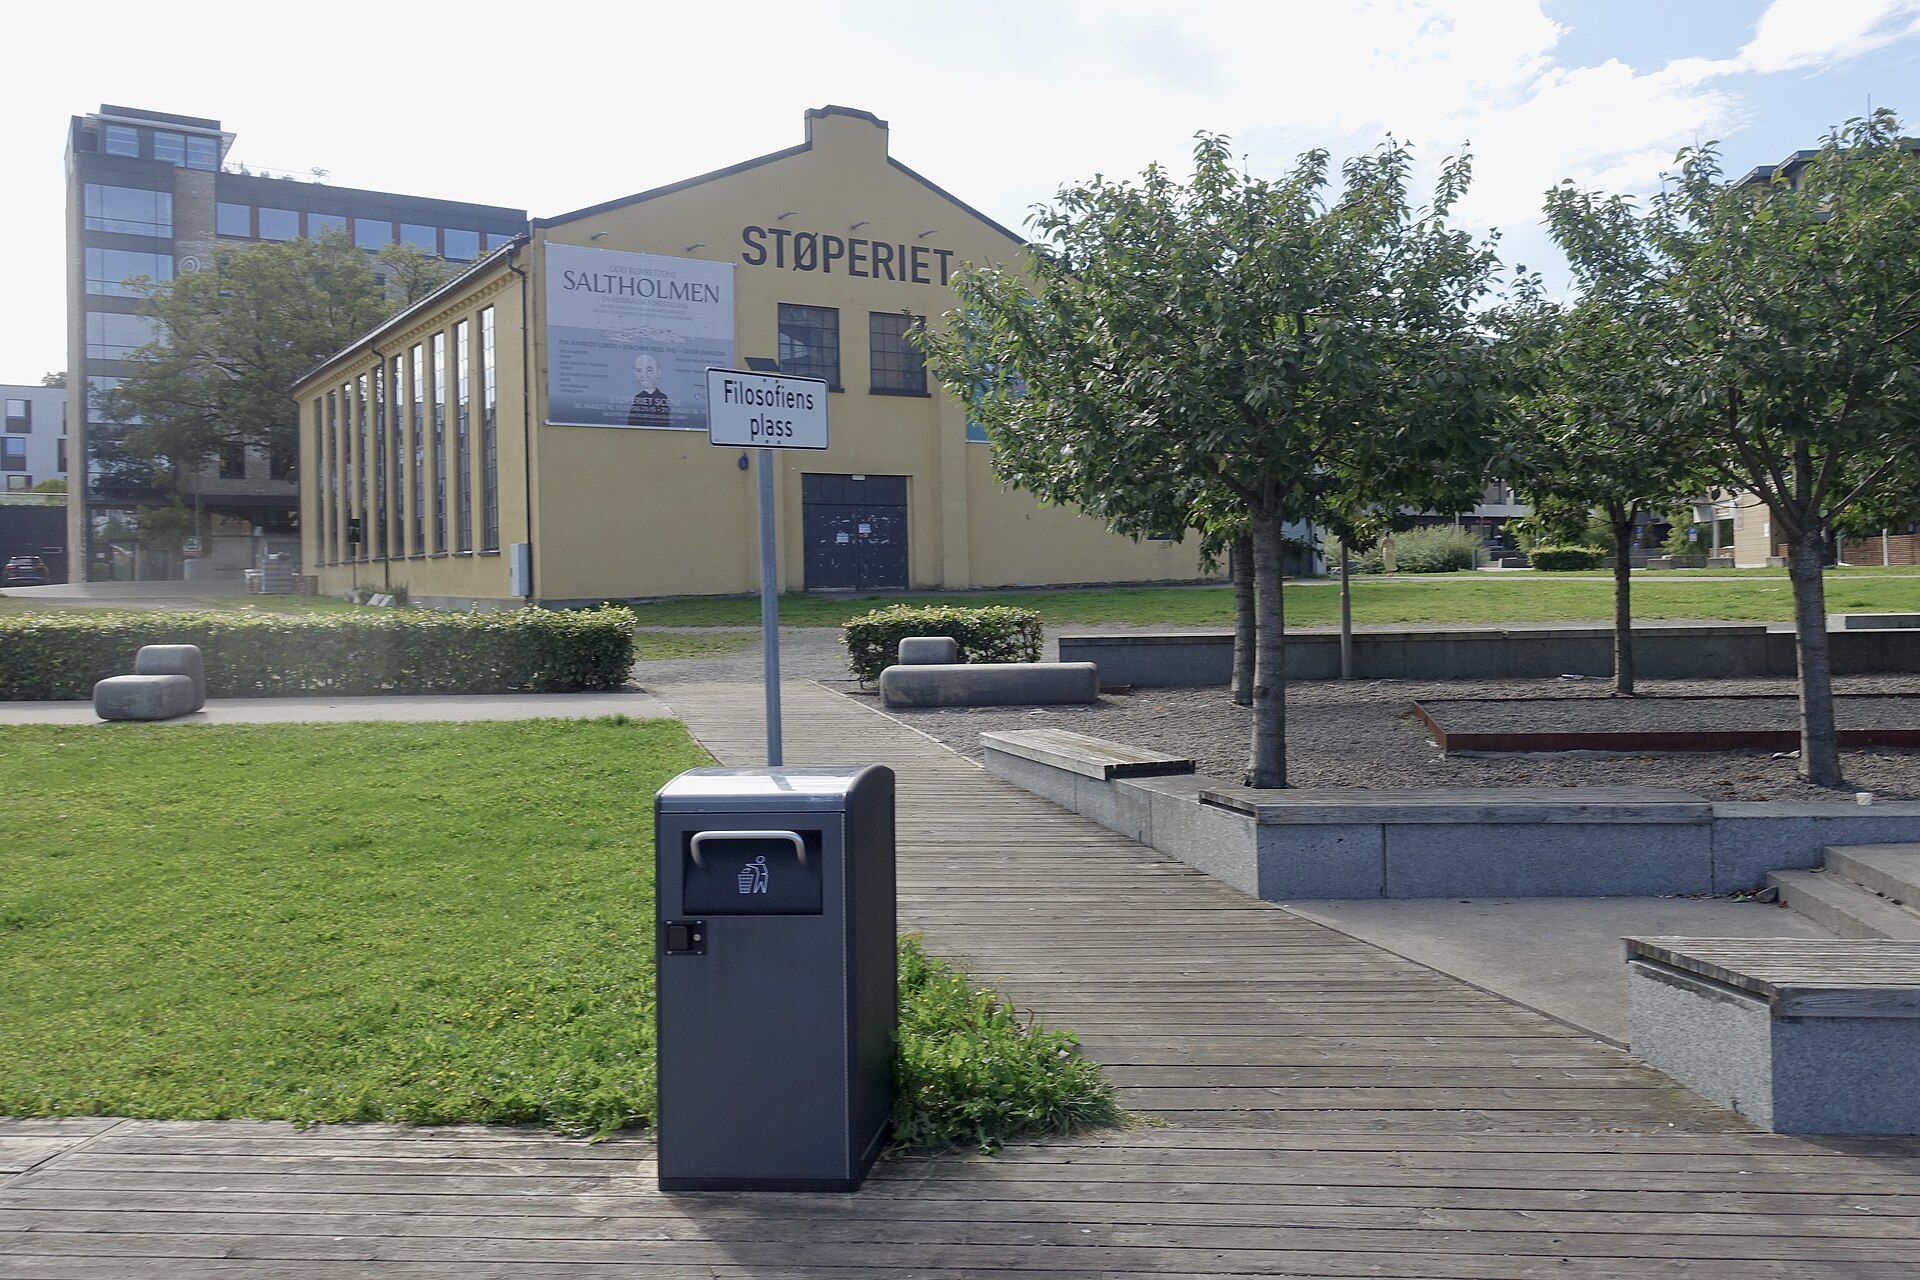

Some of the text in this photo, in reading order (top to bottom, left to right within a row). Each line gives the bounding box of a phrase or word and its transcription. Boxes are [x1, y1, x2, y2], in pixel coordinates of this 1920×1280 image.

[742, 225, 954, 286] STØPERIET
[563, 270, 719, 303] SALTHOLMEN
[724, 379, 814, 410] Filosofiens
[750, 413, 793, 441] plass
